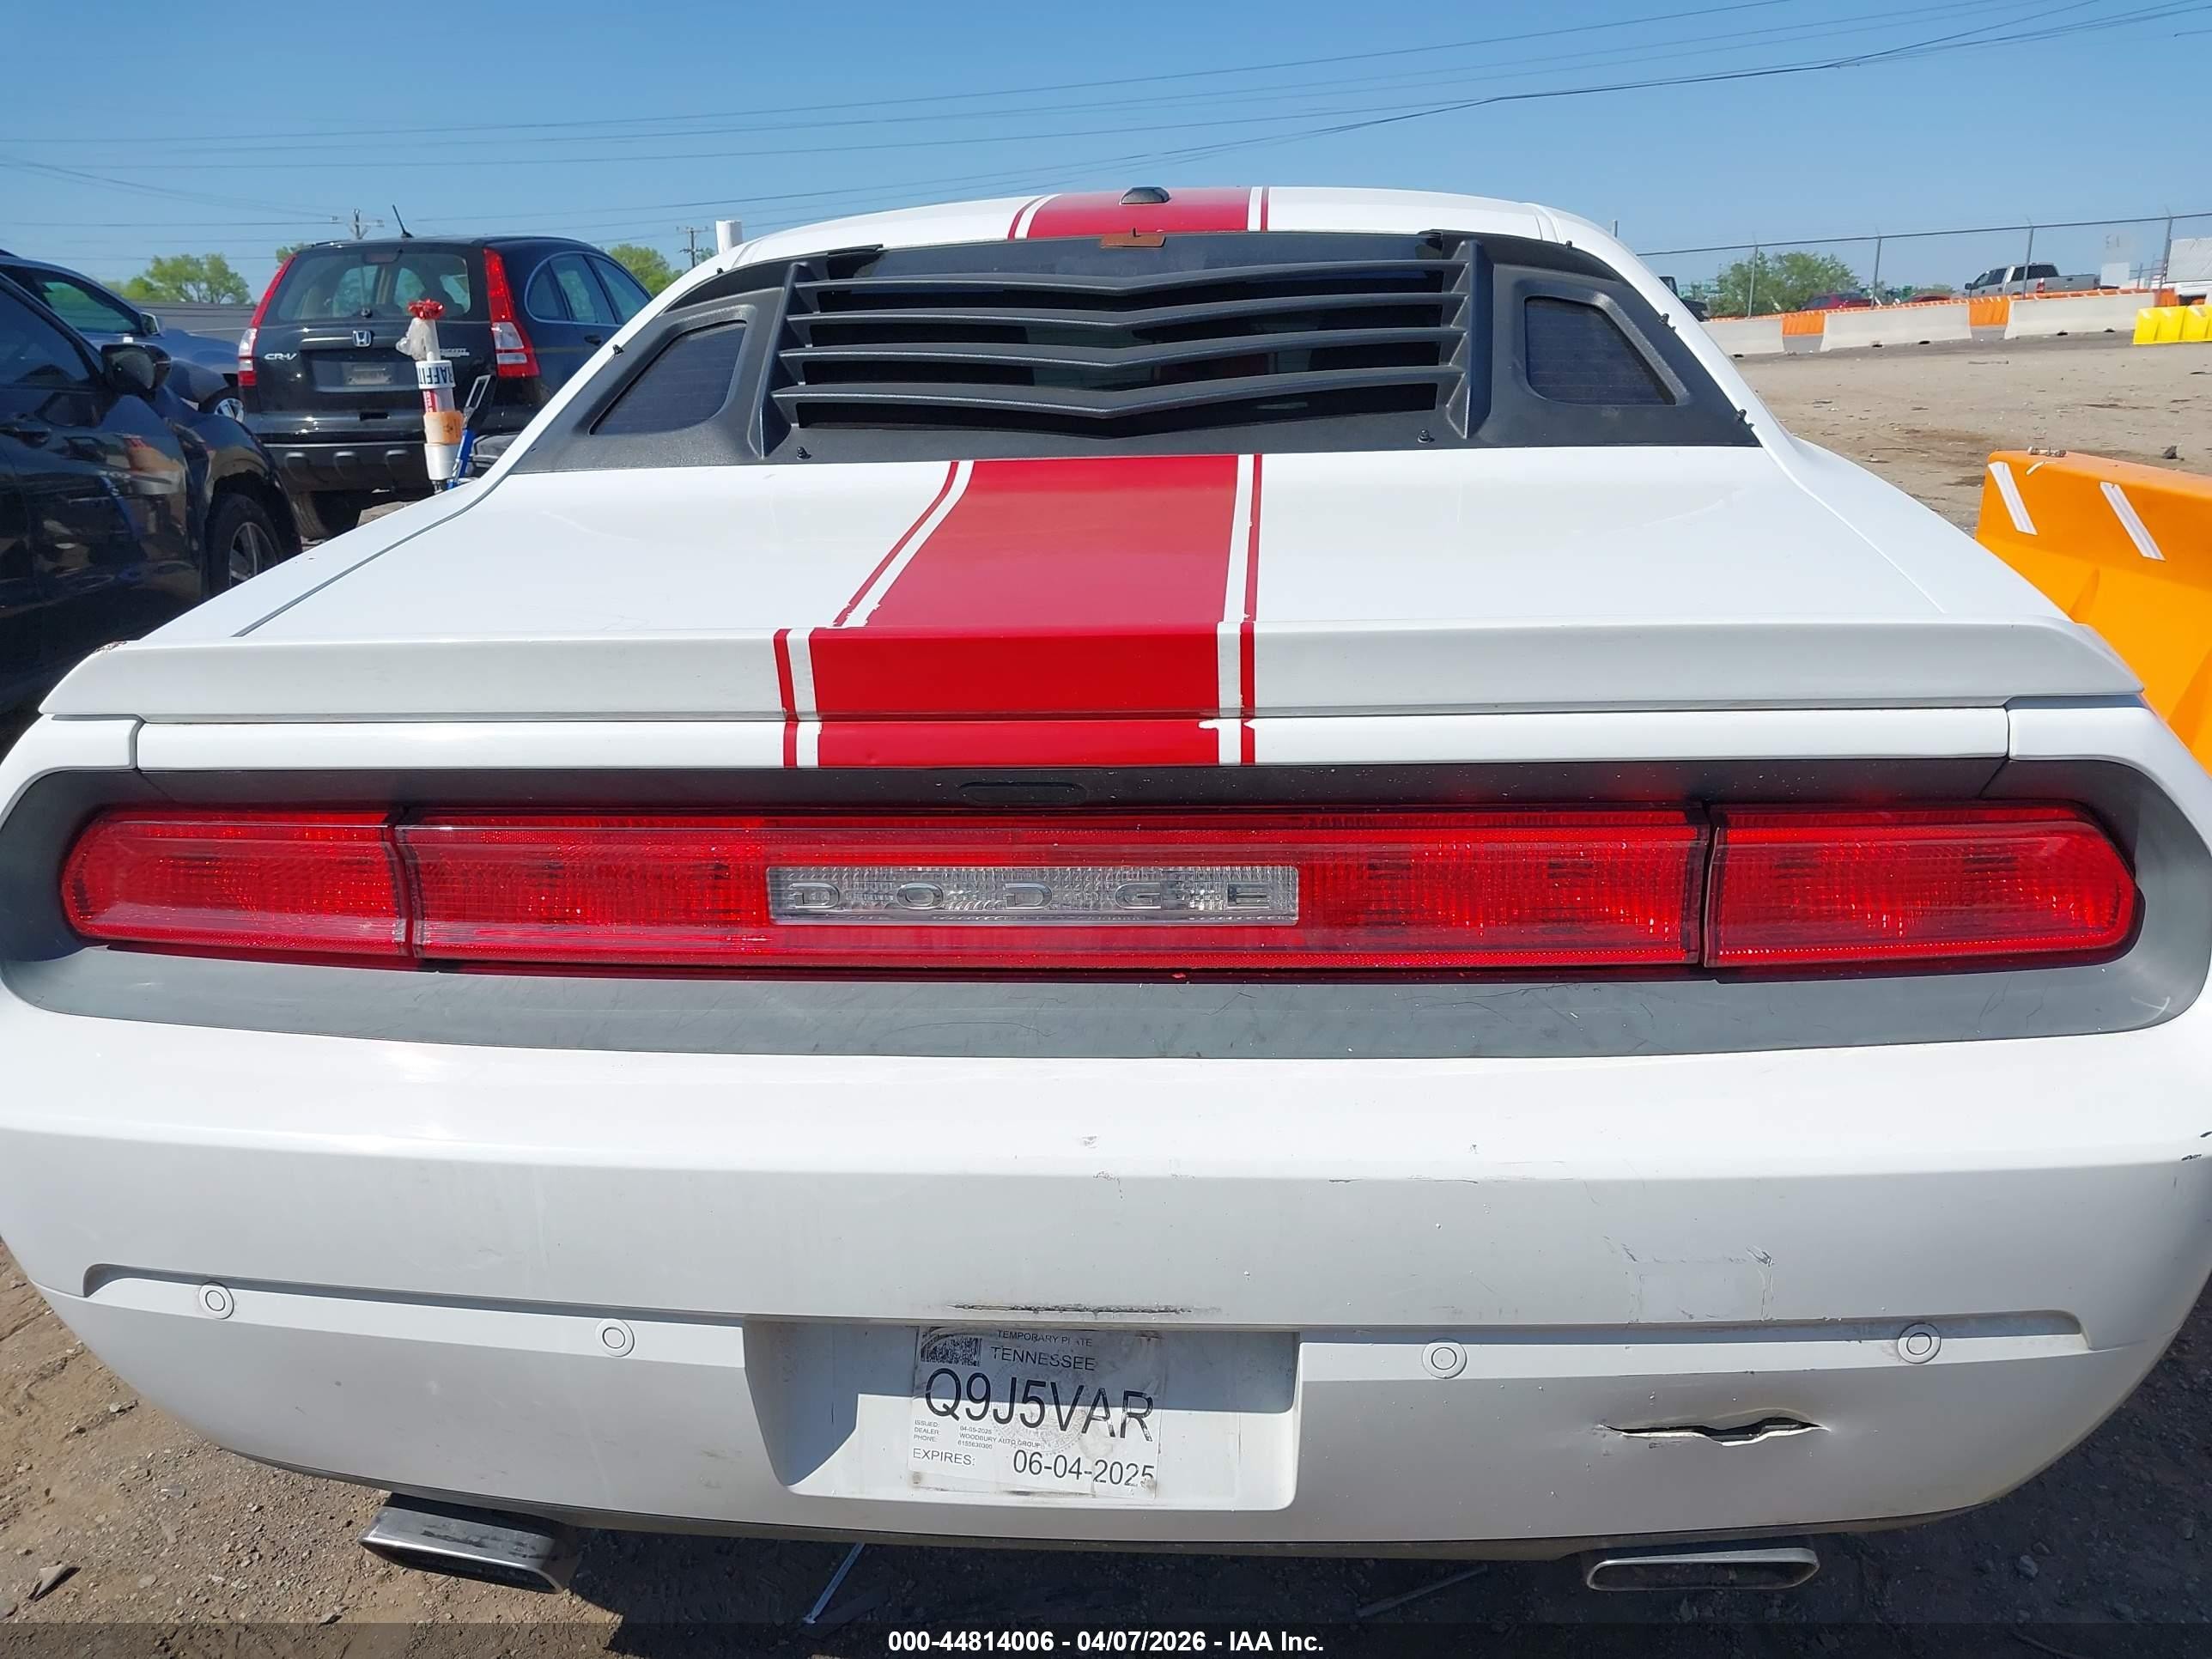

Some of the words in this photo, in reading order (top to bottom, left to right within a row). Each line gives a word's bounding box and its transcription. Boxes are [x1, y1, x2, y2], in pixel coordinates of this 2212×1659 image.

[790, 881, 1271, 910] DODGE
[997, 1329, 1059, 1344] TEMPORARY
[991, 1346, 1097, 1370] TENNESSEE
[925, 1368, 1153, 1442] Q9J5VAR
[959, 1433, 997, 1443] WOODBURY
[913, 1448, 975, 1467] EXPIRES:
[1013, 1449, 1156, 1488] 06-04-2025
